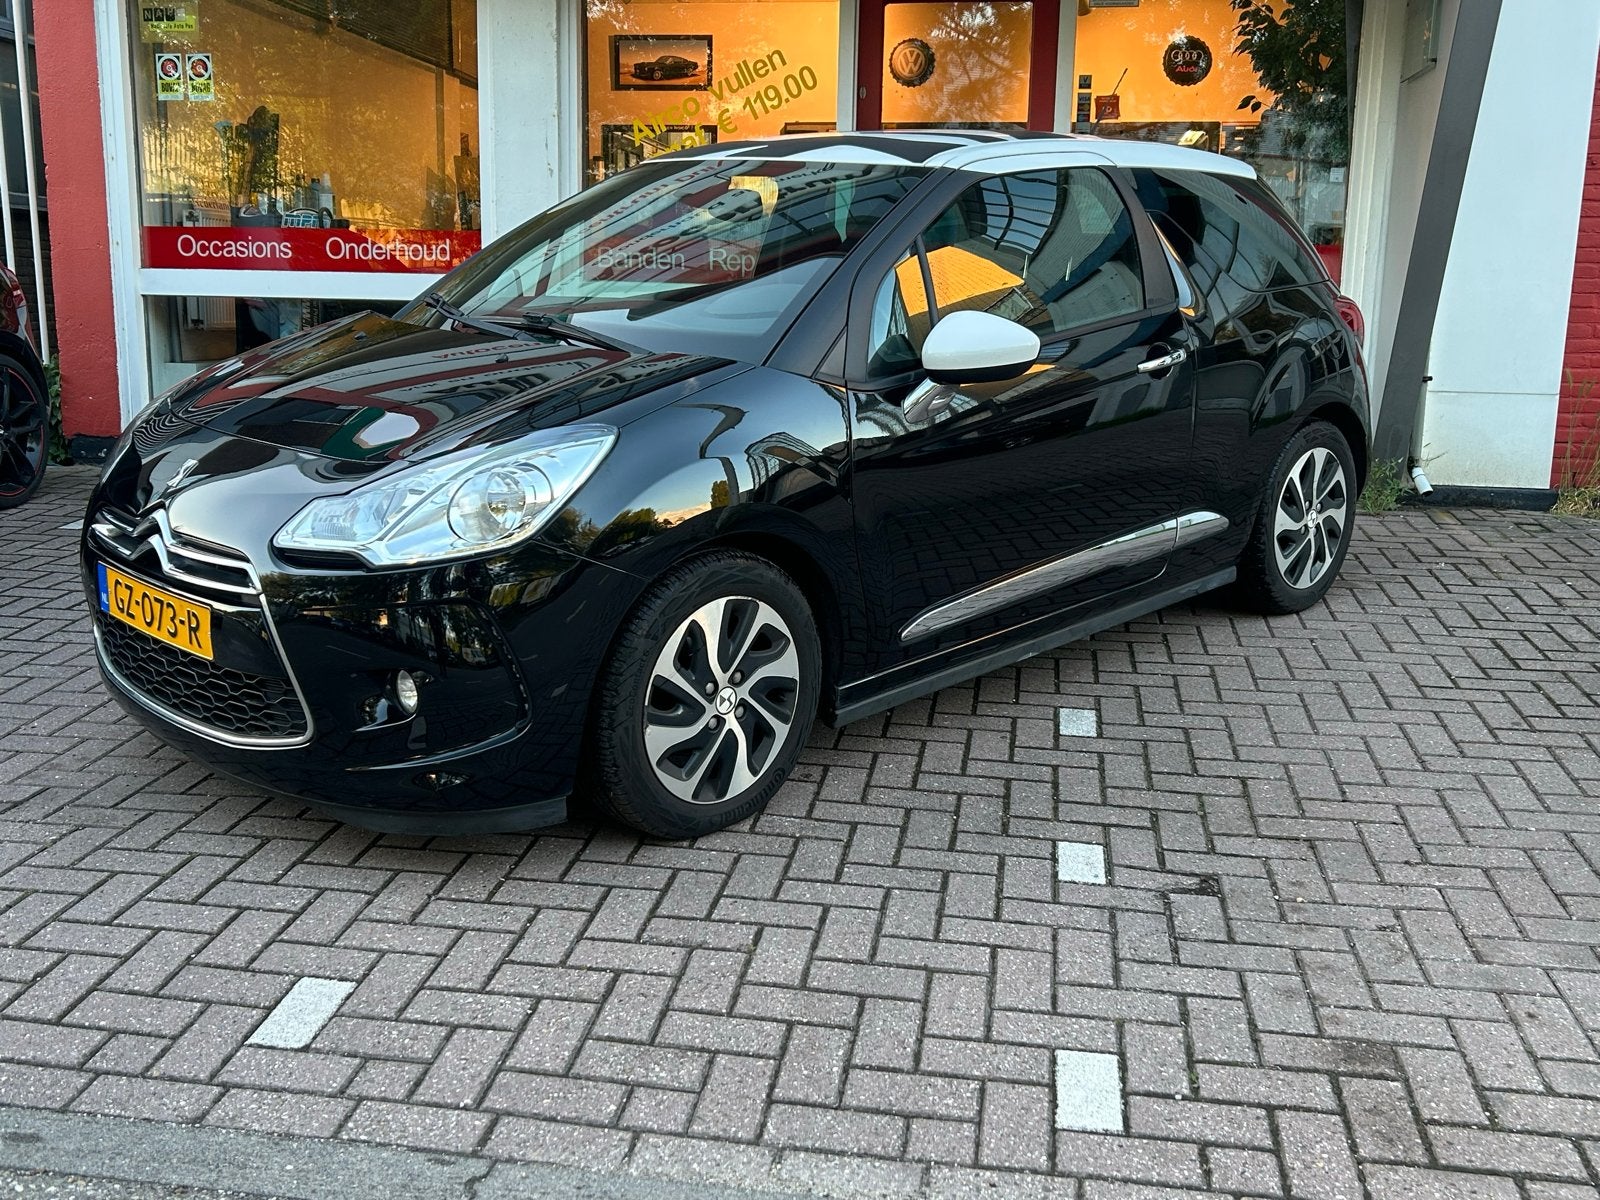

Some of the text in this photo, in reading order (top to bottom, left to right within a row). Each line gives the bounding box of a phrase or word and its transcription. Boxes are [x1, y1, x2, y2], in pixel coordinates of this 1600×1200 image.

[1175, 65, 1198, 73] Audi
[632, 49, 787, 147] Airco vullen
[716, 107, 738, 134] €
[742, 65, 818, 121] 119.00
[177, 234, 450, 261] Occasions Onderhoud
[597, 246, 756, 273] Banden Rep
[101, 578, 203, 649] NL GZ-073-R
